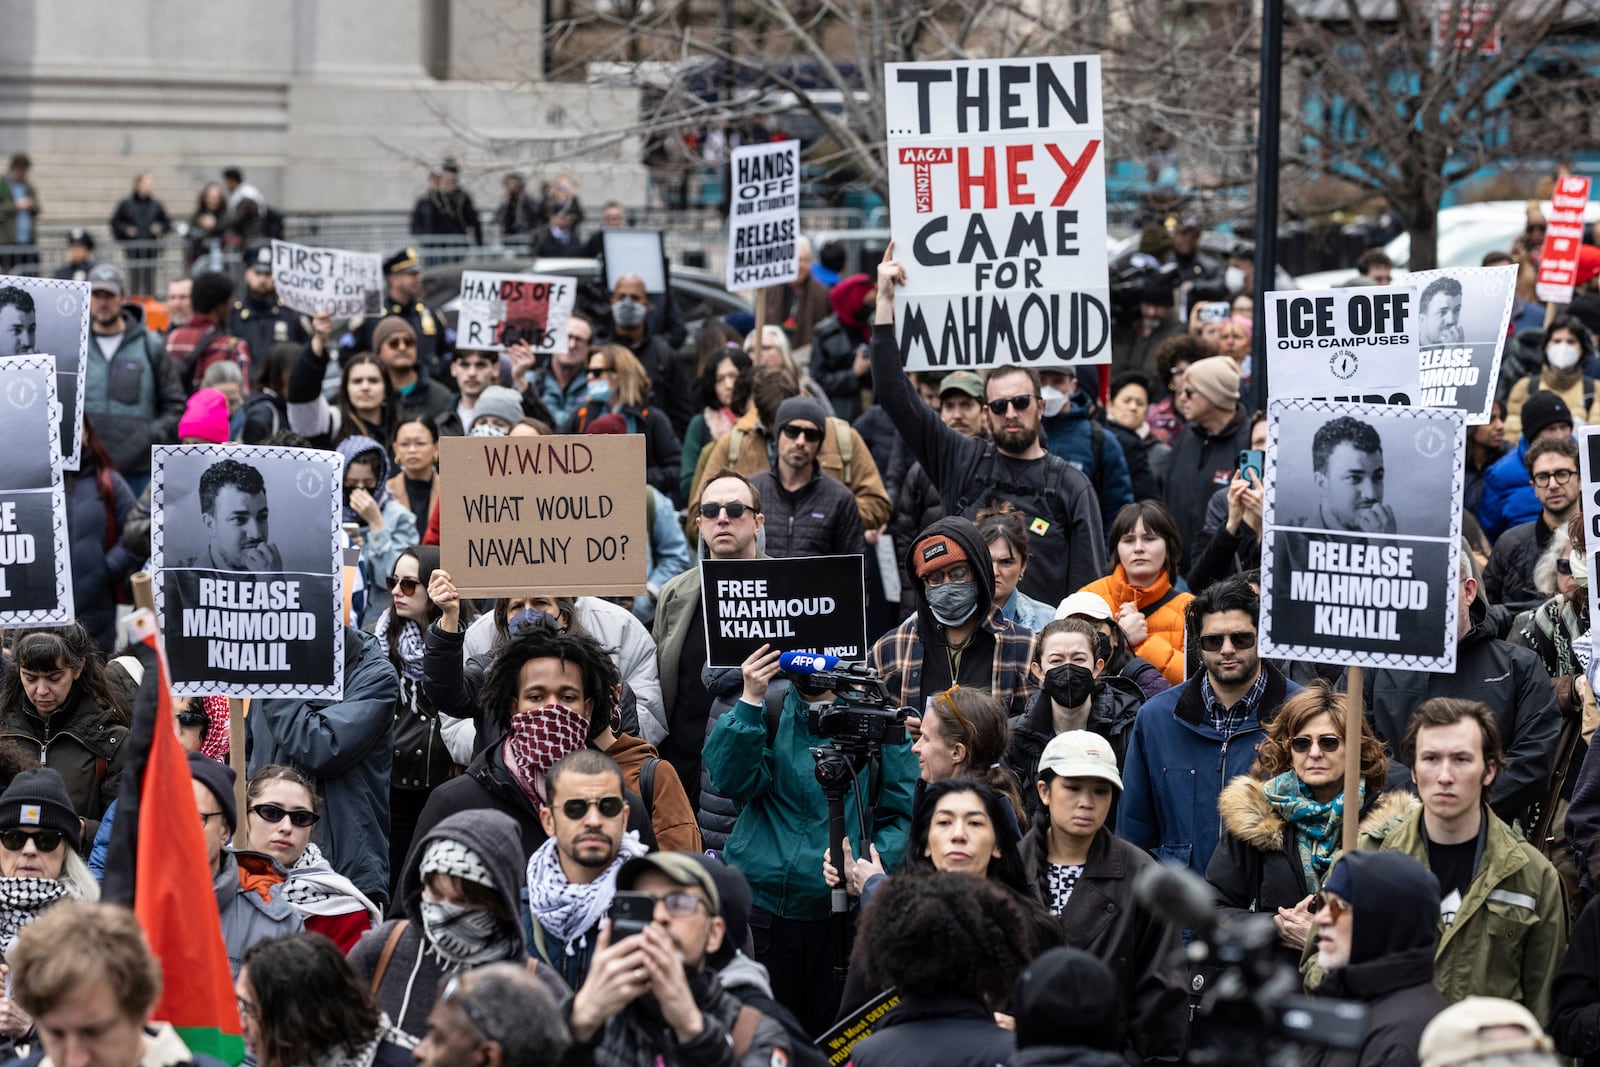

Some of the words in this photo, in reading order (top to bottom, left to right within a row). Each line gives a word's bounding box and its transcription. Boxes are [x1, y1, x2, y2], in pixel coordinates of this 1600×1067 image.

[738, 149, 794, 185] HANDS
[903, 149, 948, 162] MAGA
[739, 178, 794, 200] OFF
[898, 139, 1101, 213] THEY
[737, 201, 755, 216] OUR
[758, 194, 795, 213] STUDENTS
[736, 218, 795, 250] RELEASE
[912, 210, 1080, 267] CAME
[275, 244, 336, 277] FIRST
[735, 243, 795, 269] MAHMOUD
[278, 270, 324, 290] came
[335, 278, 364, 295] for
[734, 263, 795, 284] KHALIL
[975, 258, 1043, 292] FOR
[463, 278, 524, 301] HANDS
[533, 283, 567, 302] OFF
[901, 292, 1109, 367] MAHMOUD
[1276, 296, 1335, 338] ICE
[1347, 293, 1410, 336] OFF
[1277, 339, 1314, 350] OUR
[1318, 335, 1410, 349] CAMPUSES
[1420, 348, 1473, 370] ELEASE
[1420, 367, 1480, 389] HMOUD
[463, 494, 524, 523] WHAT
[536, 495, 613, 521] WOULD
[468, 536, 571, 568] NAVALNY
[586, 535, 629, 563] DO?
[1308, 540, 1414, 578] RELEASE
[199, 577, 300, 610] RELEASE
[716, 580, 768, 598] FREE
[1290, 571, 1429, 611] MAHMOUD
[718, 597, 836, 618] MAHMOUD
[182, 608, 317, 641] MAHMOUD
[719, 620, 796, 638] KHALIL
[1313, 607, 1401, 641] KHALIL
[207, 639, 291, 671] KHALIL
[790, 655, 814, 667] AFP
[823, 645, 858, 657] NYCLU
[828, 1037, 846, 1049] We
[843, 1020, 868, 1039] Must
[865, 996, 900, 1023] DEFEAT
